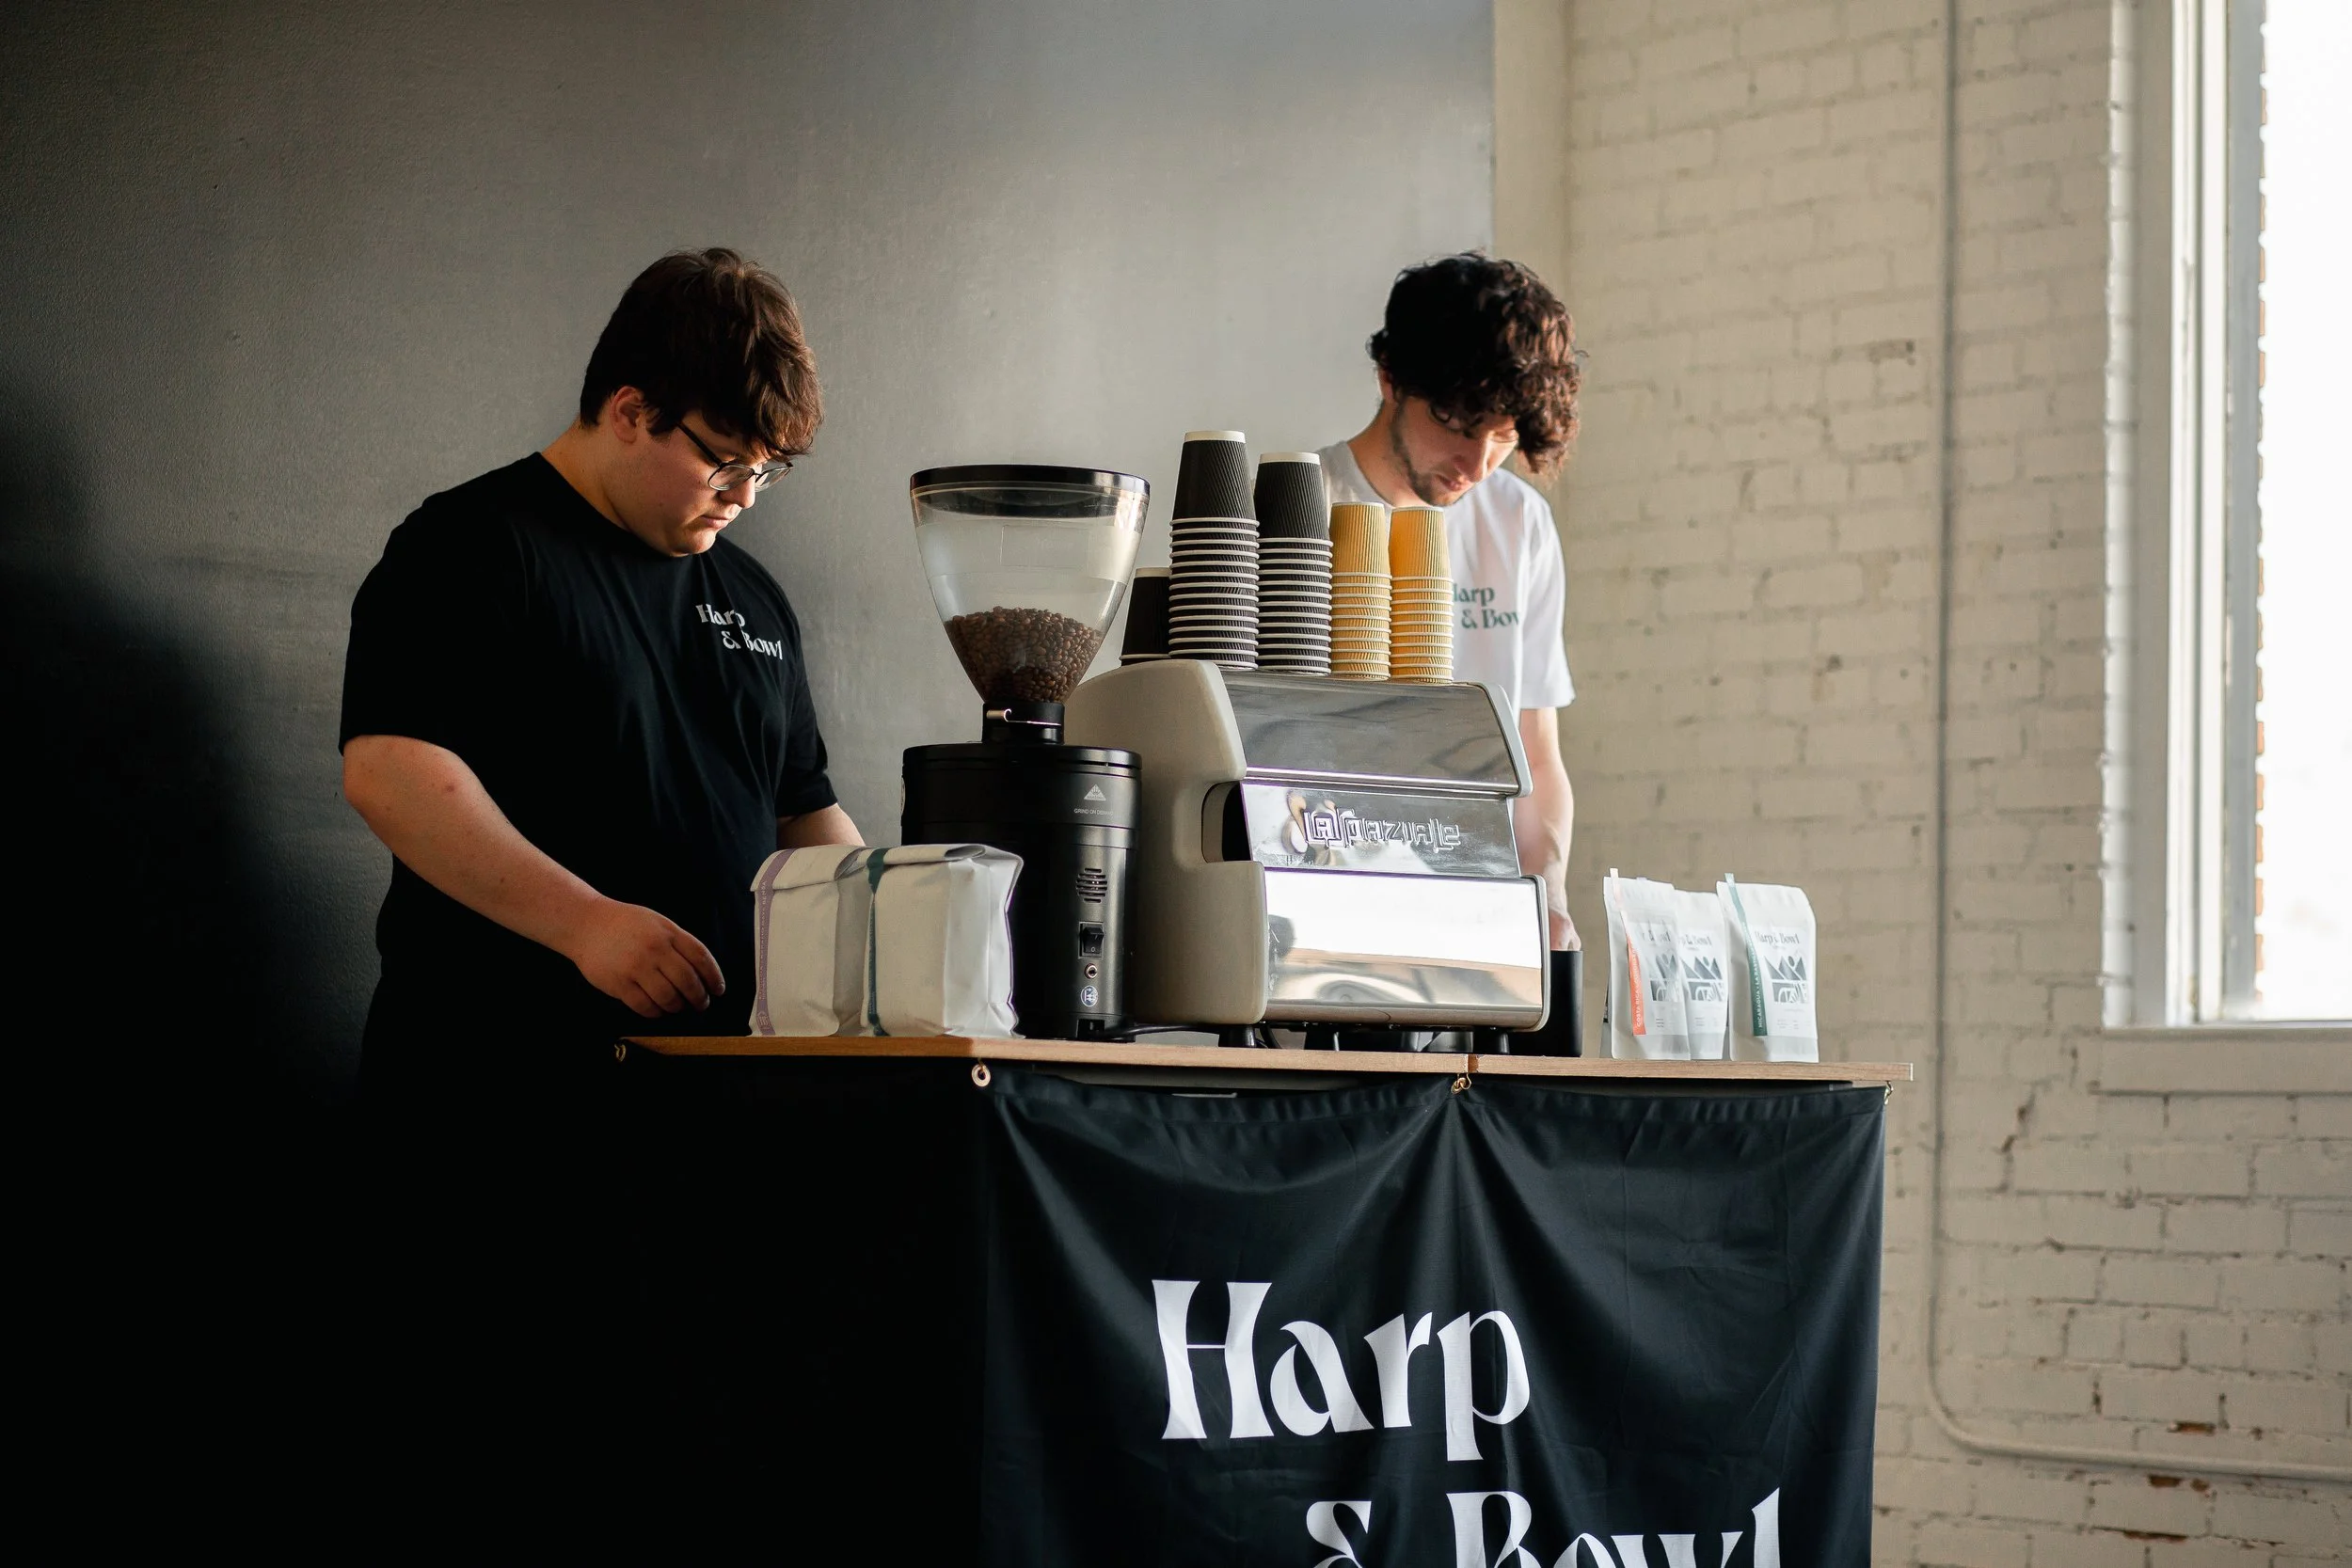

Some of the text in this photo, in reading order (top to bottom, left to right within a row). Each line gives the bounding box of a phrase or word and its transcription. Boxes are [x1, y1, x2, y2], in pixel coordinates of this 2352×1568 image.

[1461, 609, 1478, 629] &
[721, 630, 741, 650] &
[1152, 1279, 1531, 1462] Harp
